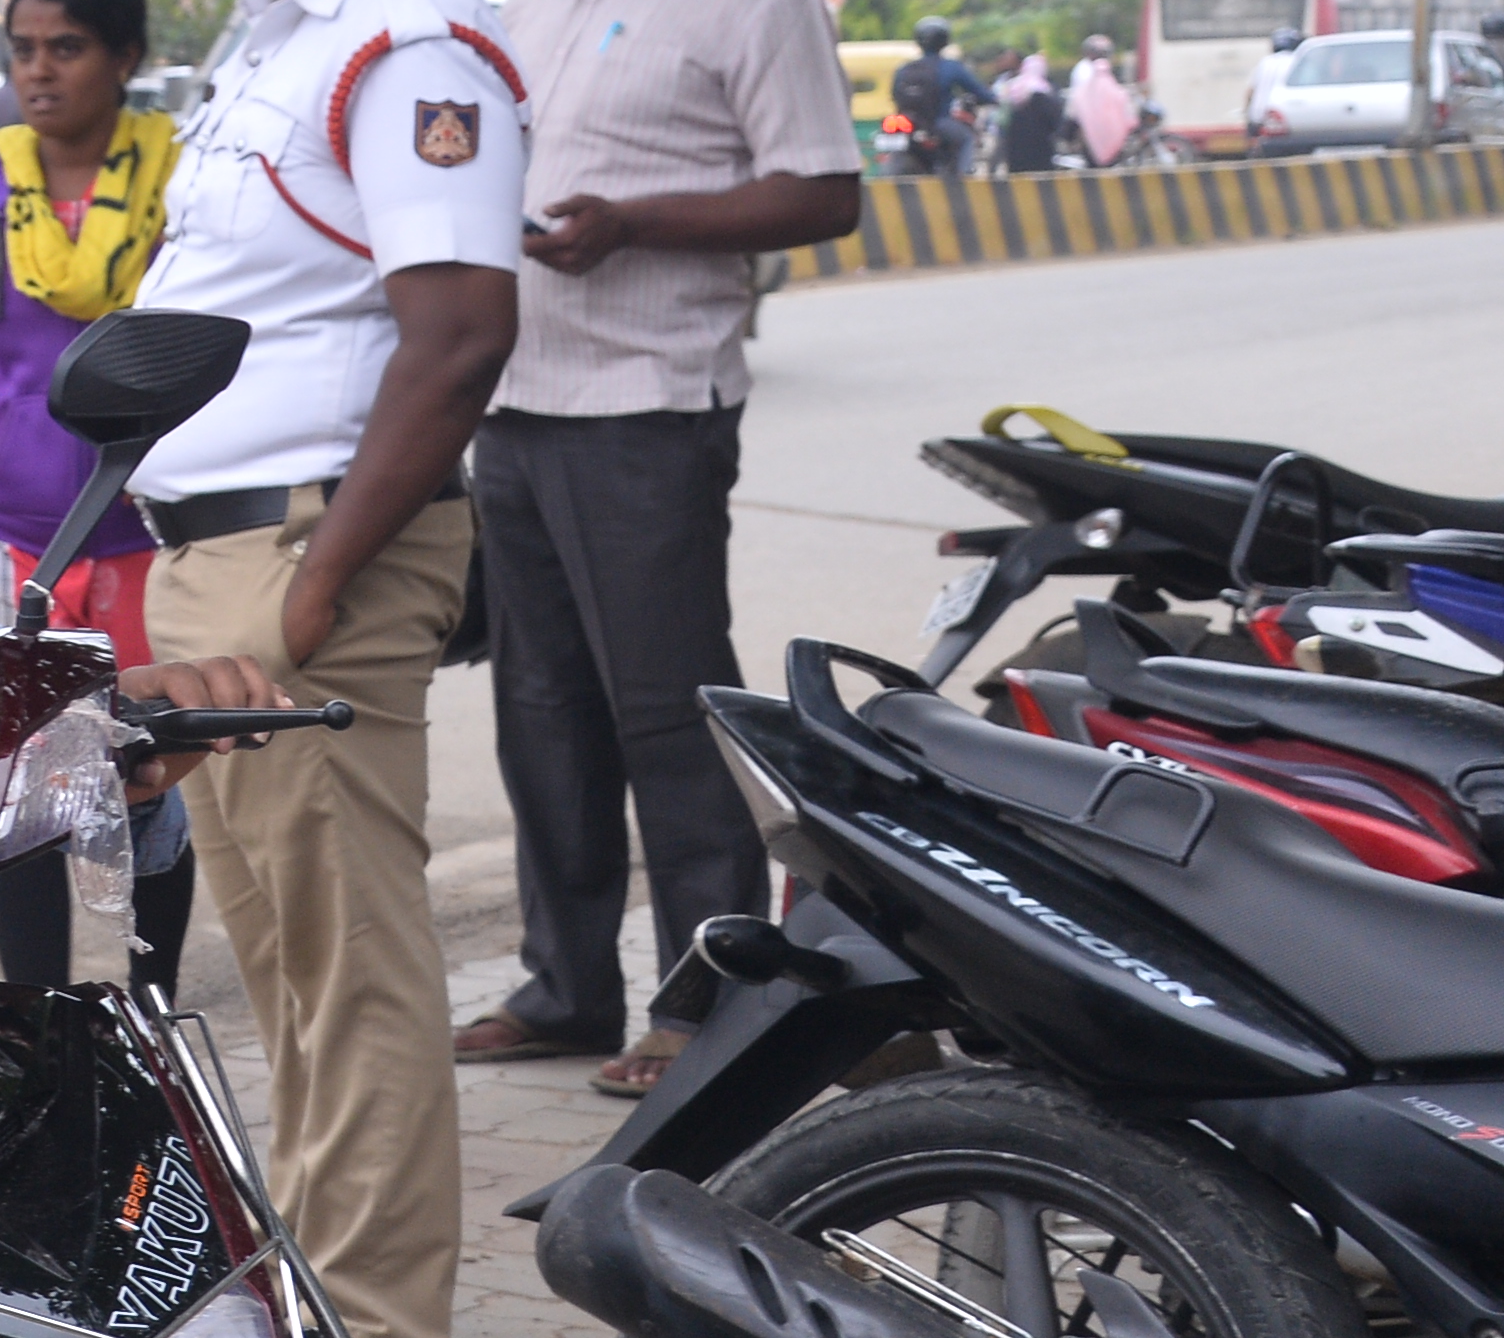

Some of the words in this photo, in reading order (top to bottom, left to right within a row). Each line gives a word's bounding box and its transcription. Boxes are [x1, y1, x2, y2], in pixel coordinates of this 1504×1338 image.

[928, 842, 1217, 1009] UNICORN
[1401, 1095, 1475, 1129] MONO
[122, 1163, 151, 1220] SPORT
